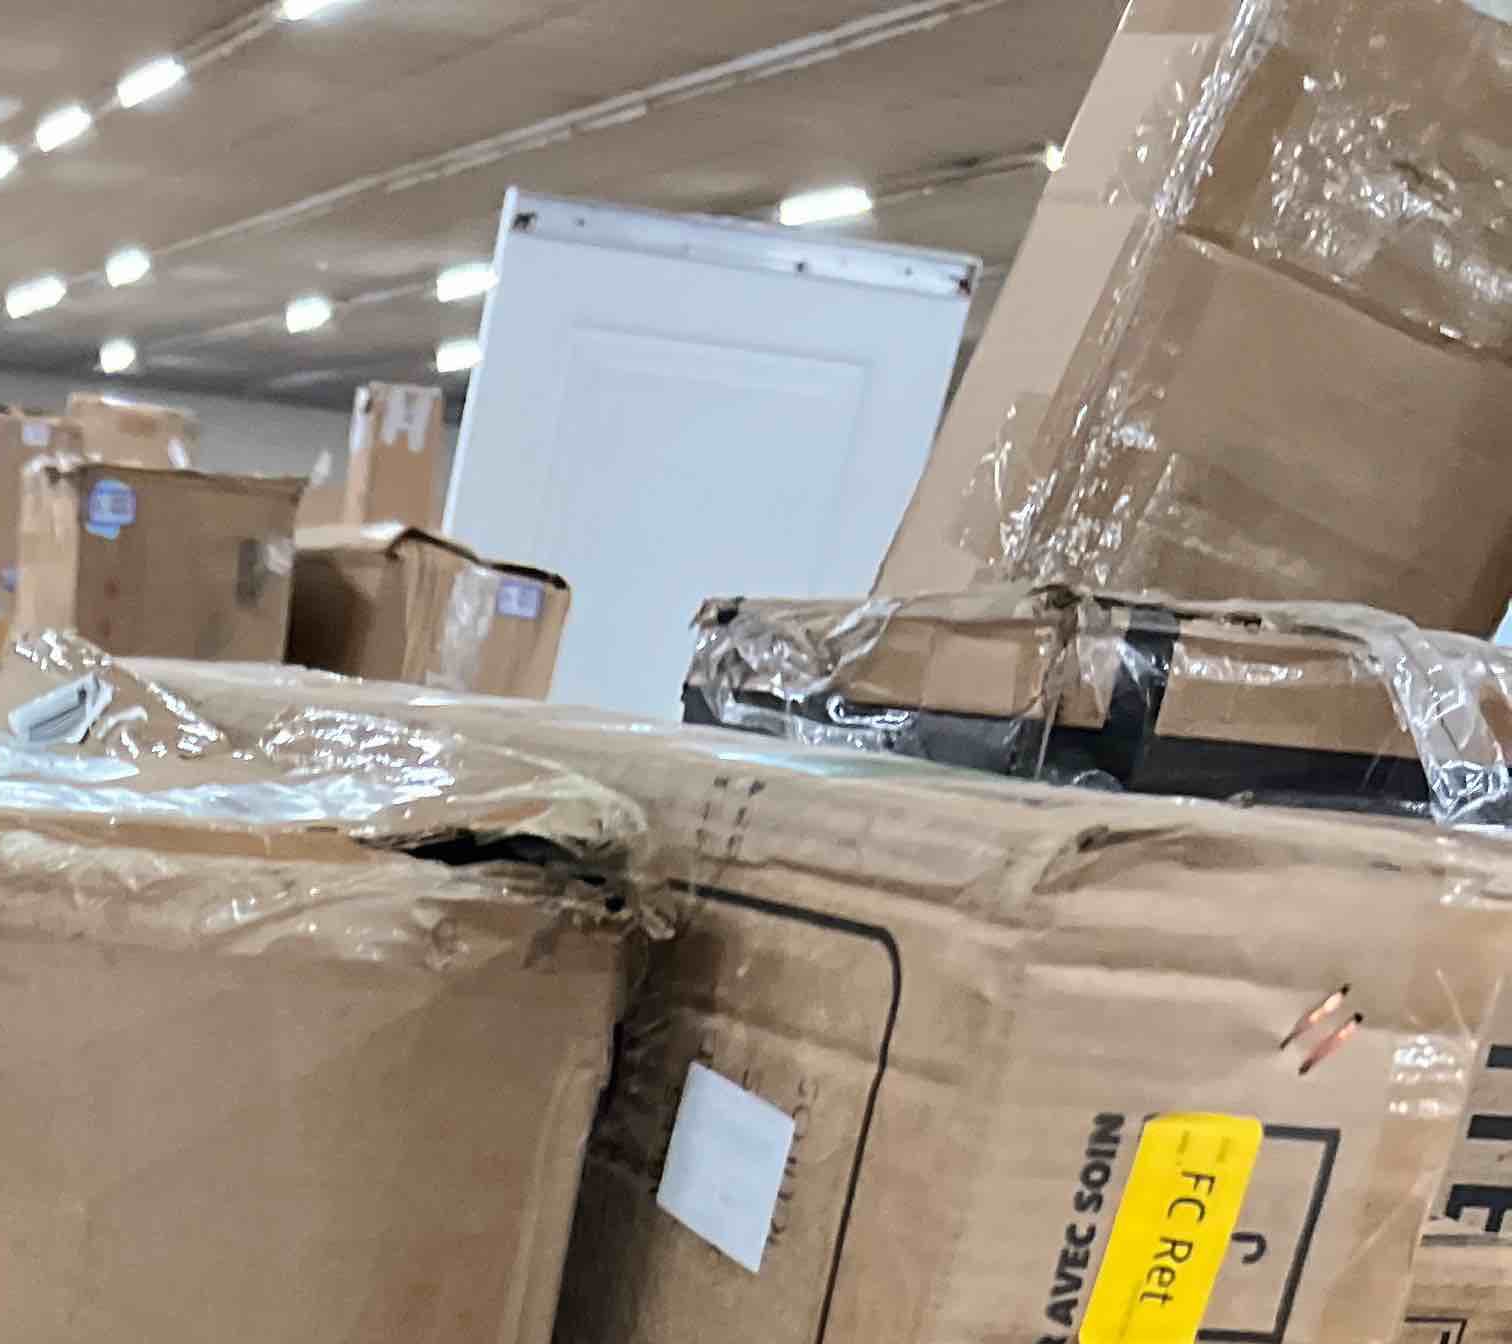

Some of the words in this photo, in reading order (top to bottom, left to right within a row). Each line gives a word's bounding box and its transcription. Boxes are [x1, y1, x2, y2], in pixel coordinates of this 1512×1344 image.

[1046, 1223, 1096, 1328] AVEC
[1074, 1112, 1125, 1214] SOIN
[1167, 1170, 1216, 1223] FC
[1140, 1236, 1193, 1308] Ret
